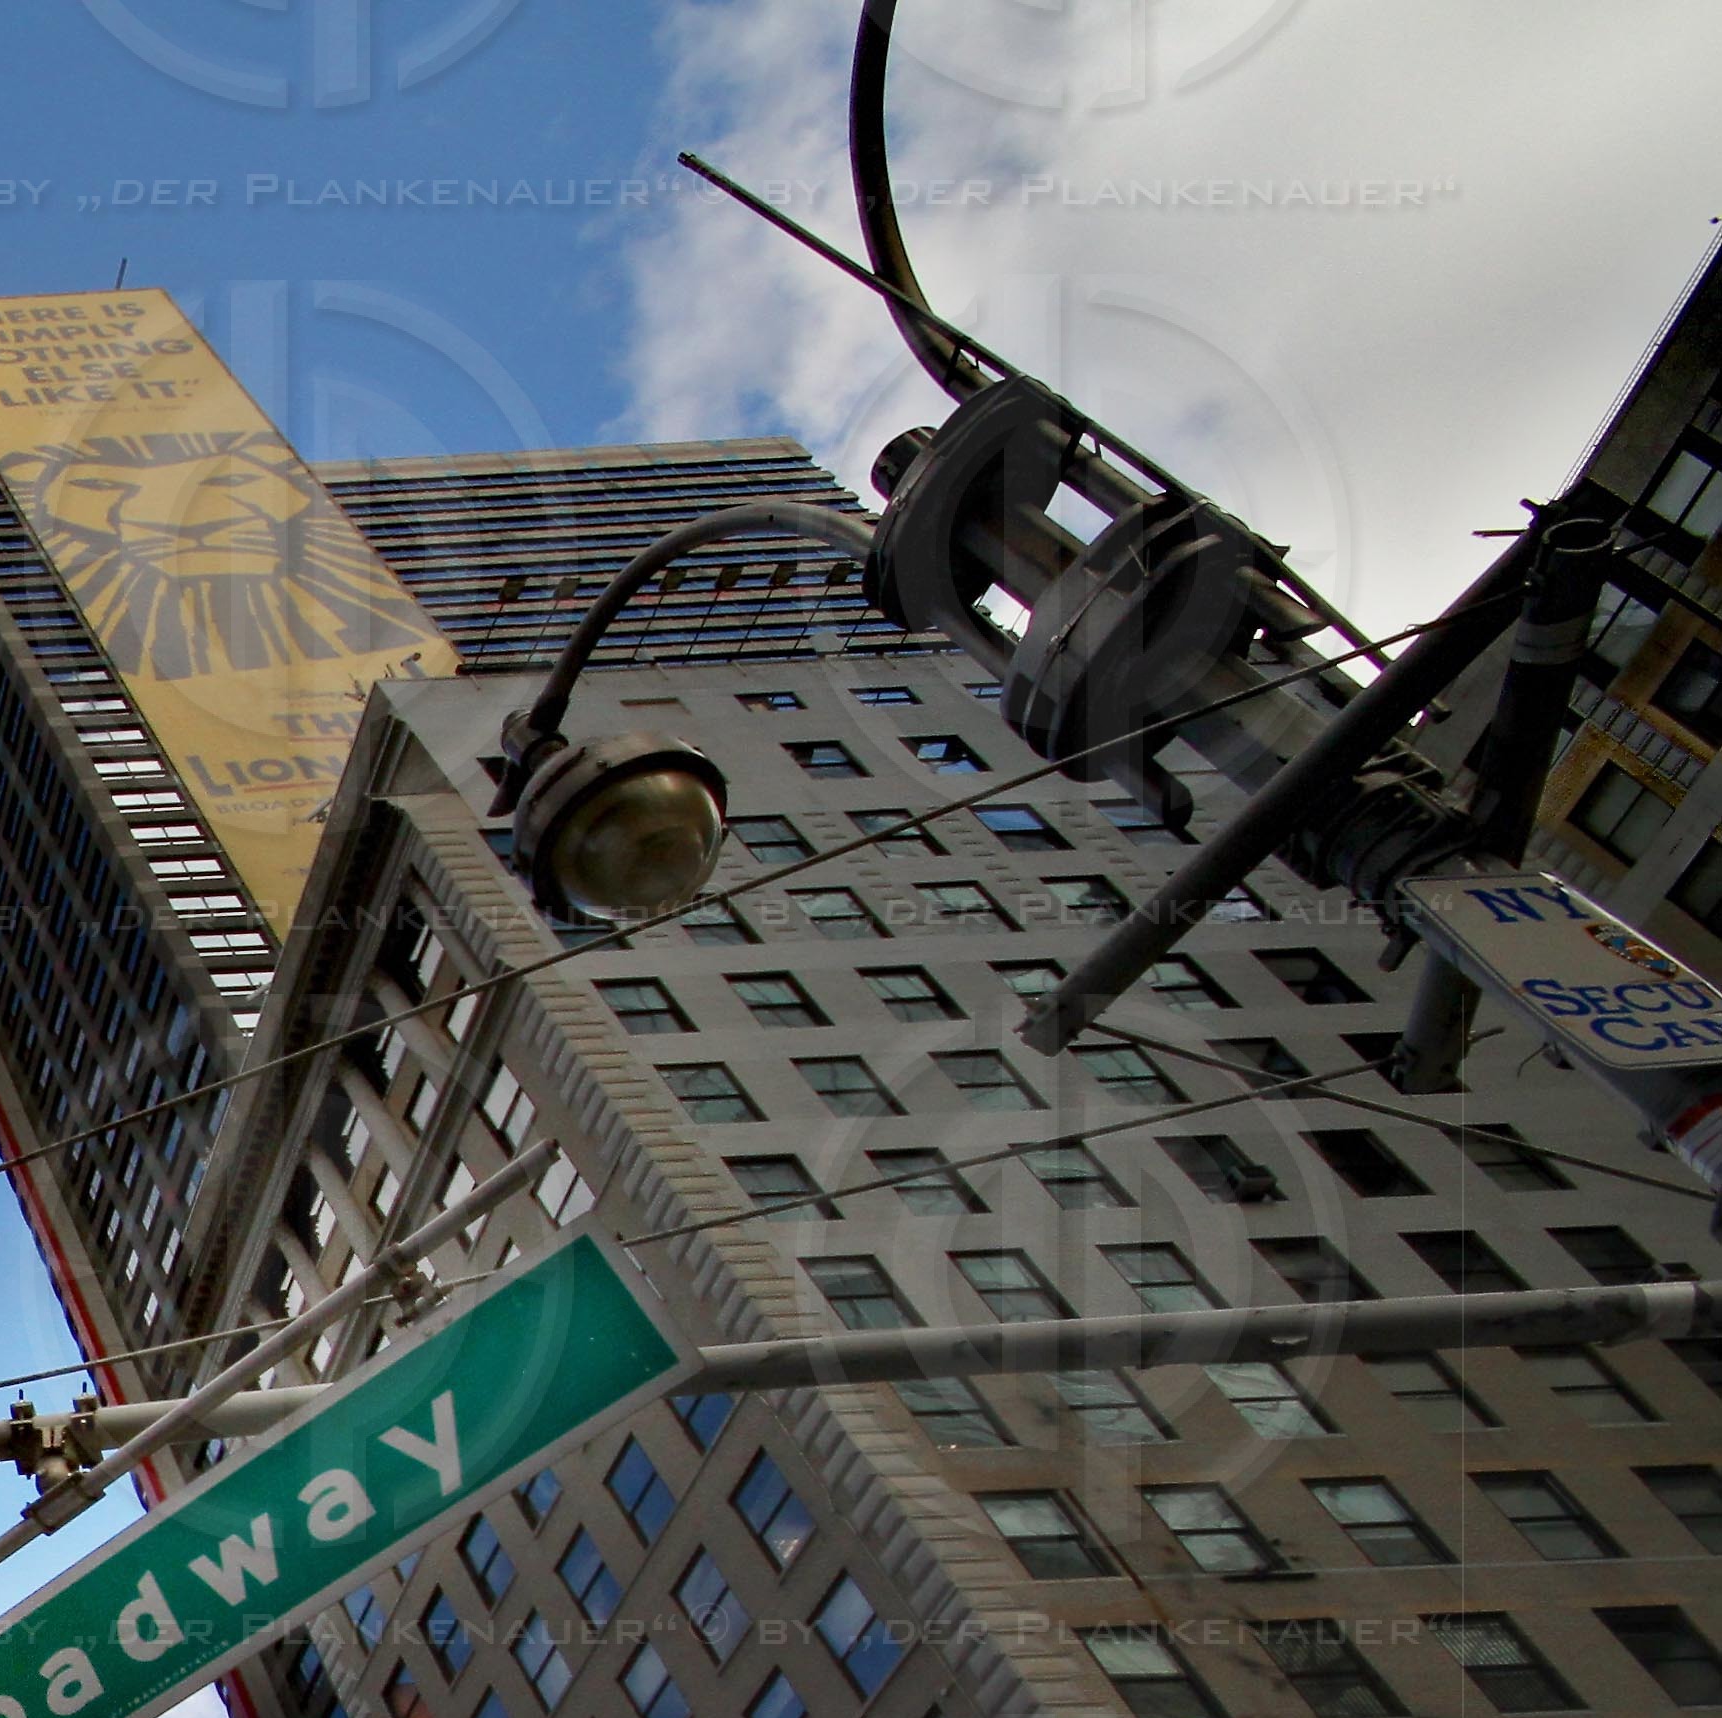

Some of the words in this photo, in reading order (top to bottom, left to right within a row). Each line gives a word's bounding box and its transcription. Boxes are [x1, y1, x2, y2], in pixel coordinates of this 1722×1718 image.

[101, 302, 146, 318] IS
[22, 362, 142, 384] ELSE
[1522, 978, 1722, 1016] SECU
